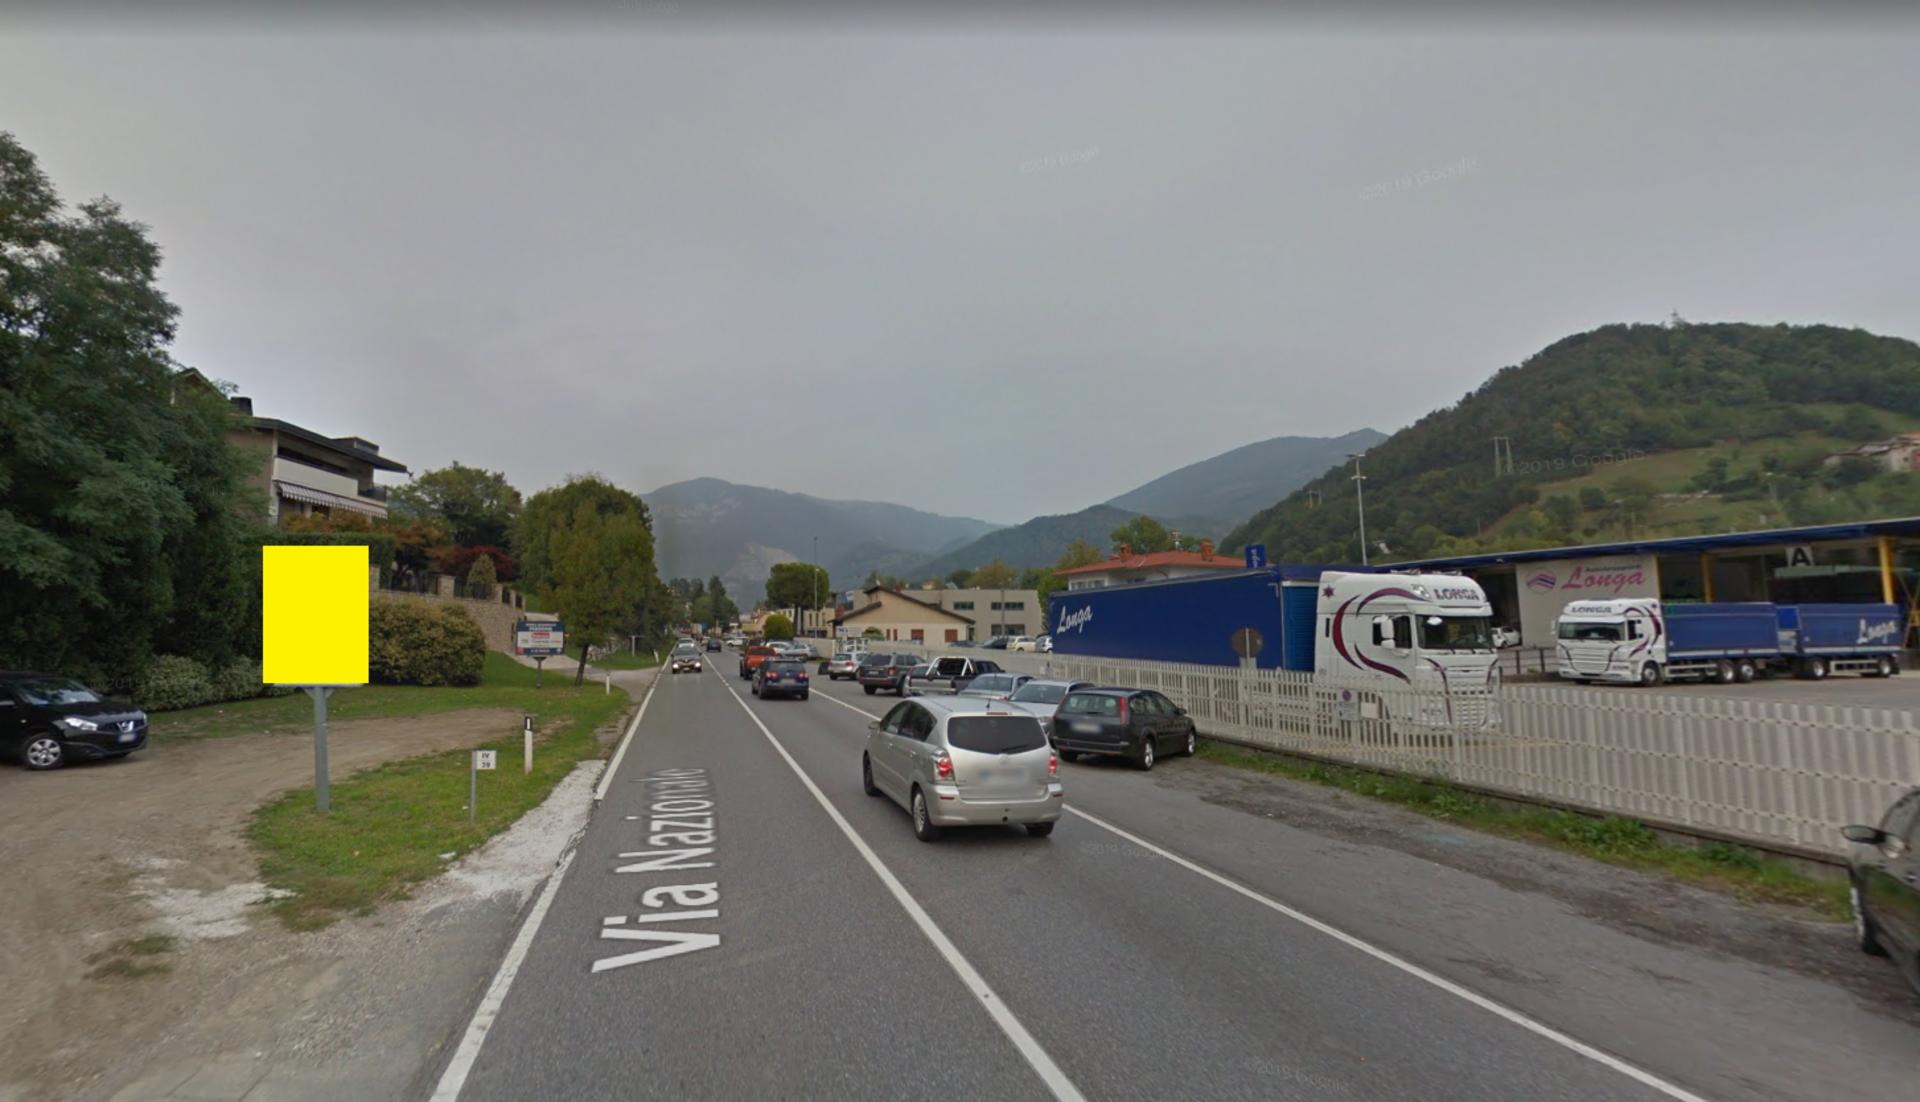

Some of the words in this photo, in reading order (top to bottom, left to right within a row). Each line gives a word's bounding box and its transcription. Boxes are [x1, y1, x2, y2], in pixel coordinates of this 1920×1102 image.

[1792, 547, 1812, 566] A
[1562, 564, 1645, 593] Longa
[1433, 588, 1480, 601] LONGA
[1056, 605, 1094, 634] Longa
[1572, 606, 1612, 614] LONGA
